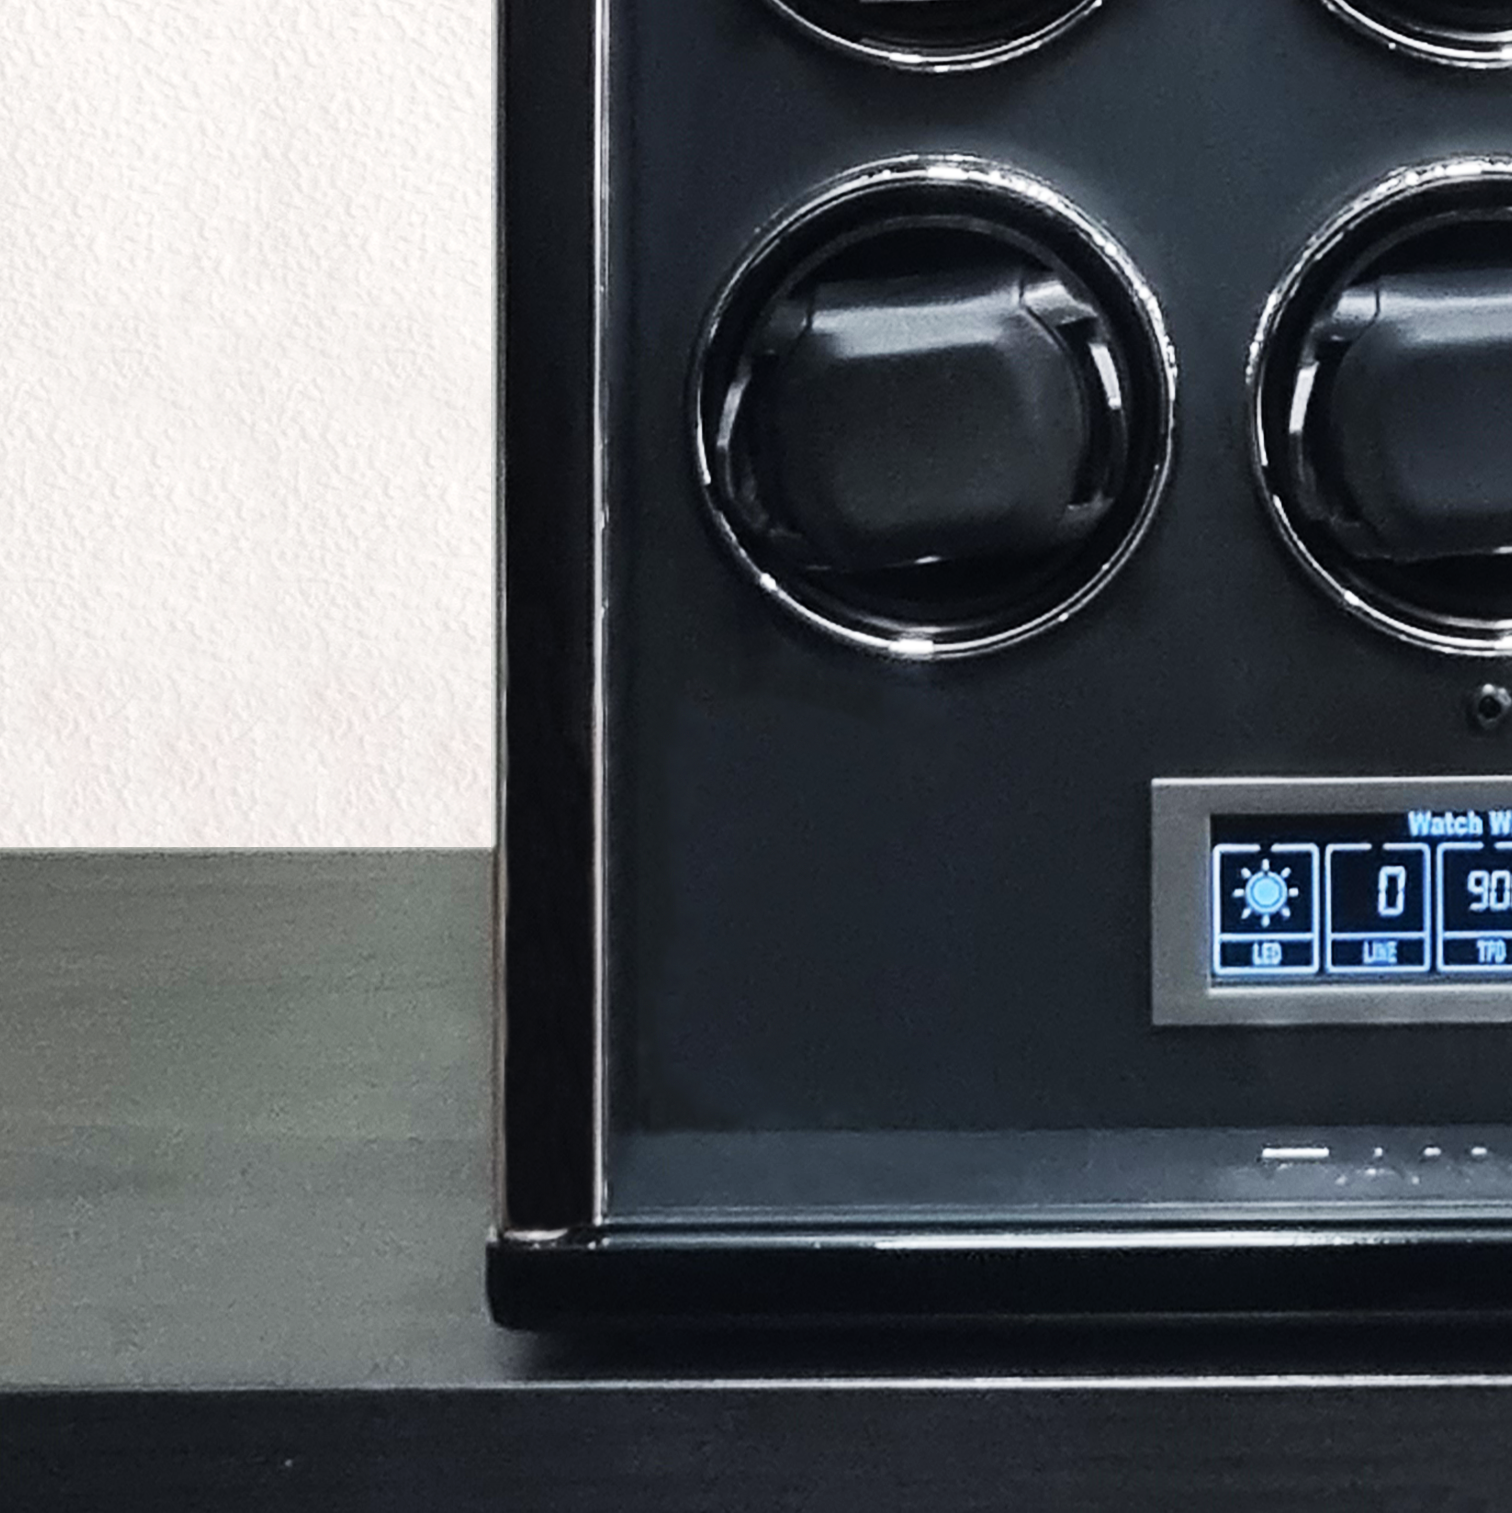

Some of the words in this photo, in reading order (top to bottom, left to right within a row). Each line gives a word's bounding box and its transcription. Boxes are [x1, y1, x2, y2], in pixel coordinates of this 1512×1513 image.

[1407, 810, 1484, 837] Watch
[1377, 865, 1406, 917] 0
[1252, 941, 1283, 966] LED
[1362, 939, 1399, 965] LINE
